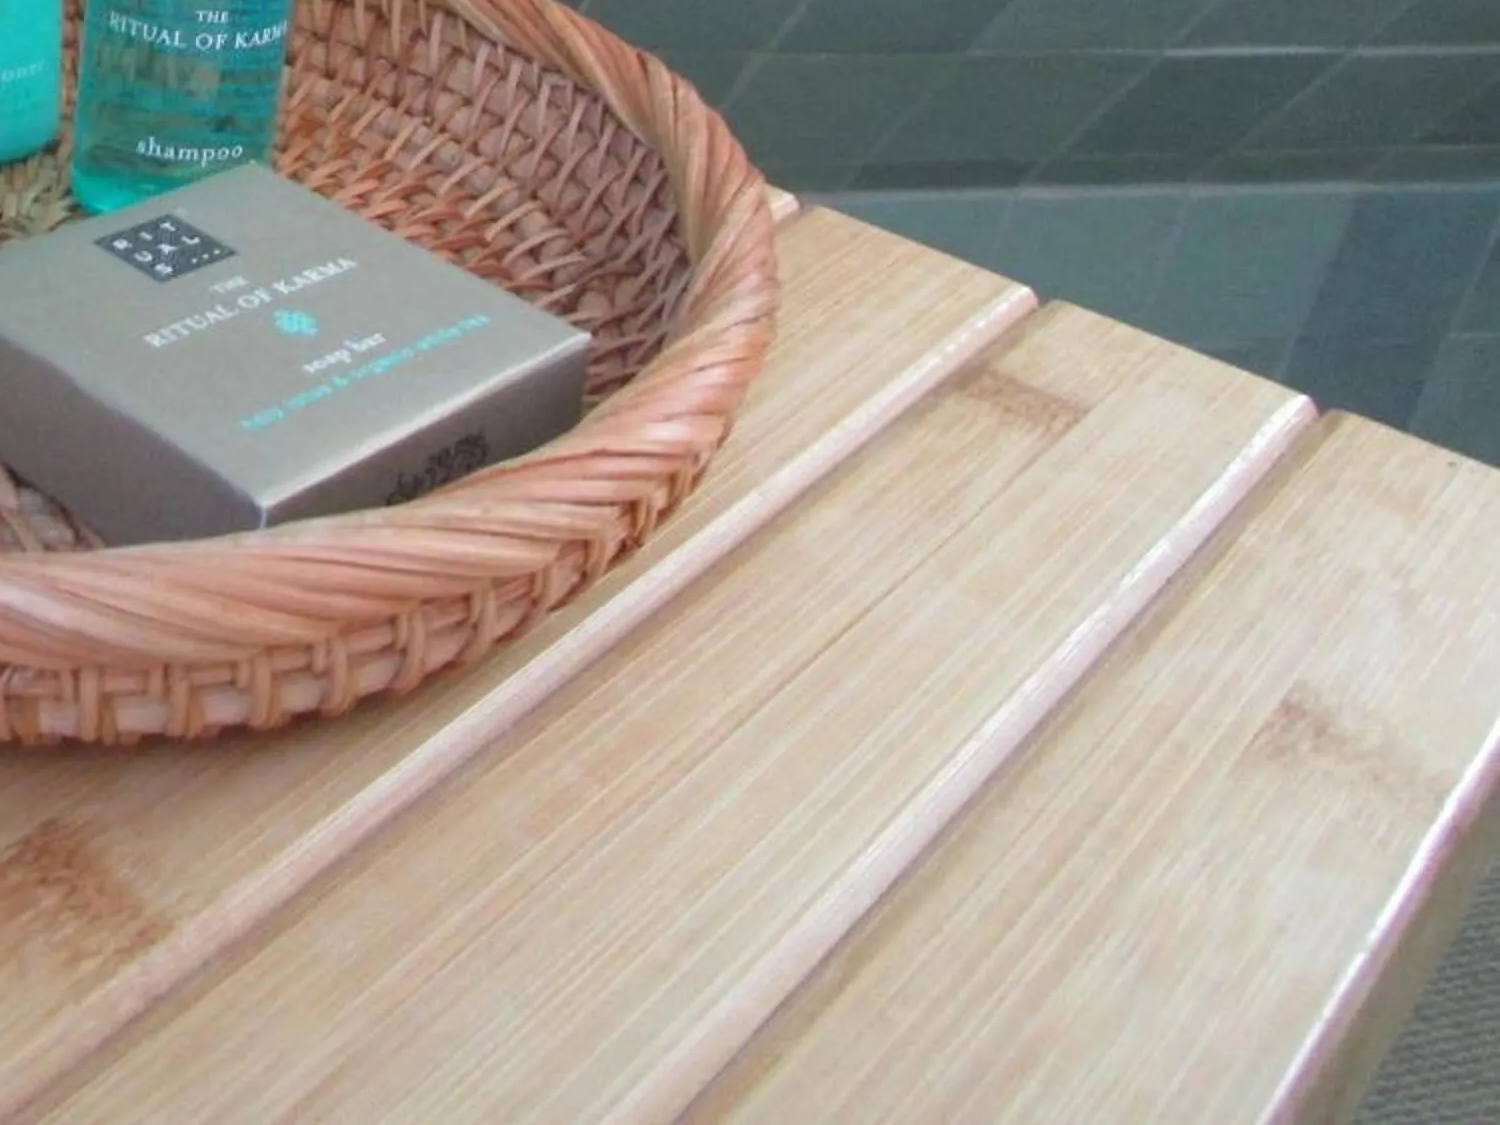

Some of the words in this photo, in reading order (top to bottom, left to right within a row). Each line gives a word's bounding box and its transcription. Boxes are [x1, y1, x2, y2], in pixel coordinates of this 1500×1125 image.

[195, 10, 229, 24] THE
[108, 10, 188, 48] RITUAL
[195, 32, 229, 51] OF
[135, 136, 244, 168] shampoo
[208, 275, 250, 294] THE
[143, 304, 240, 349] RITUAL
[237, 286, 274, 309] OF
[271, 256, 358, 295] KARMA
[344, 332, 386, 352] bar
